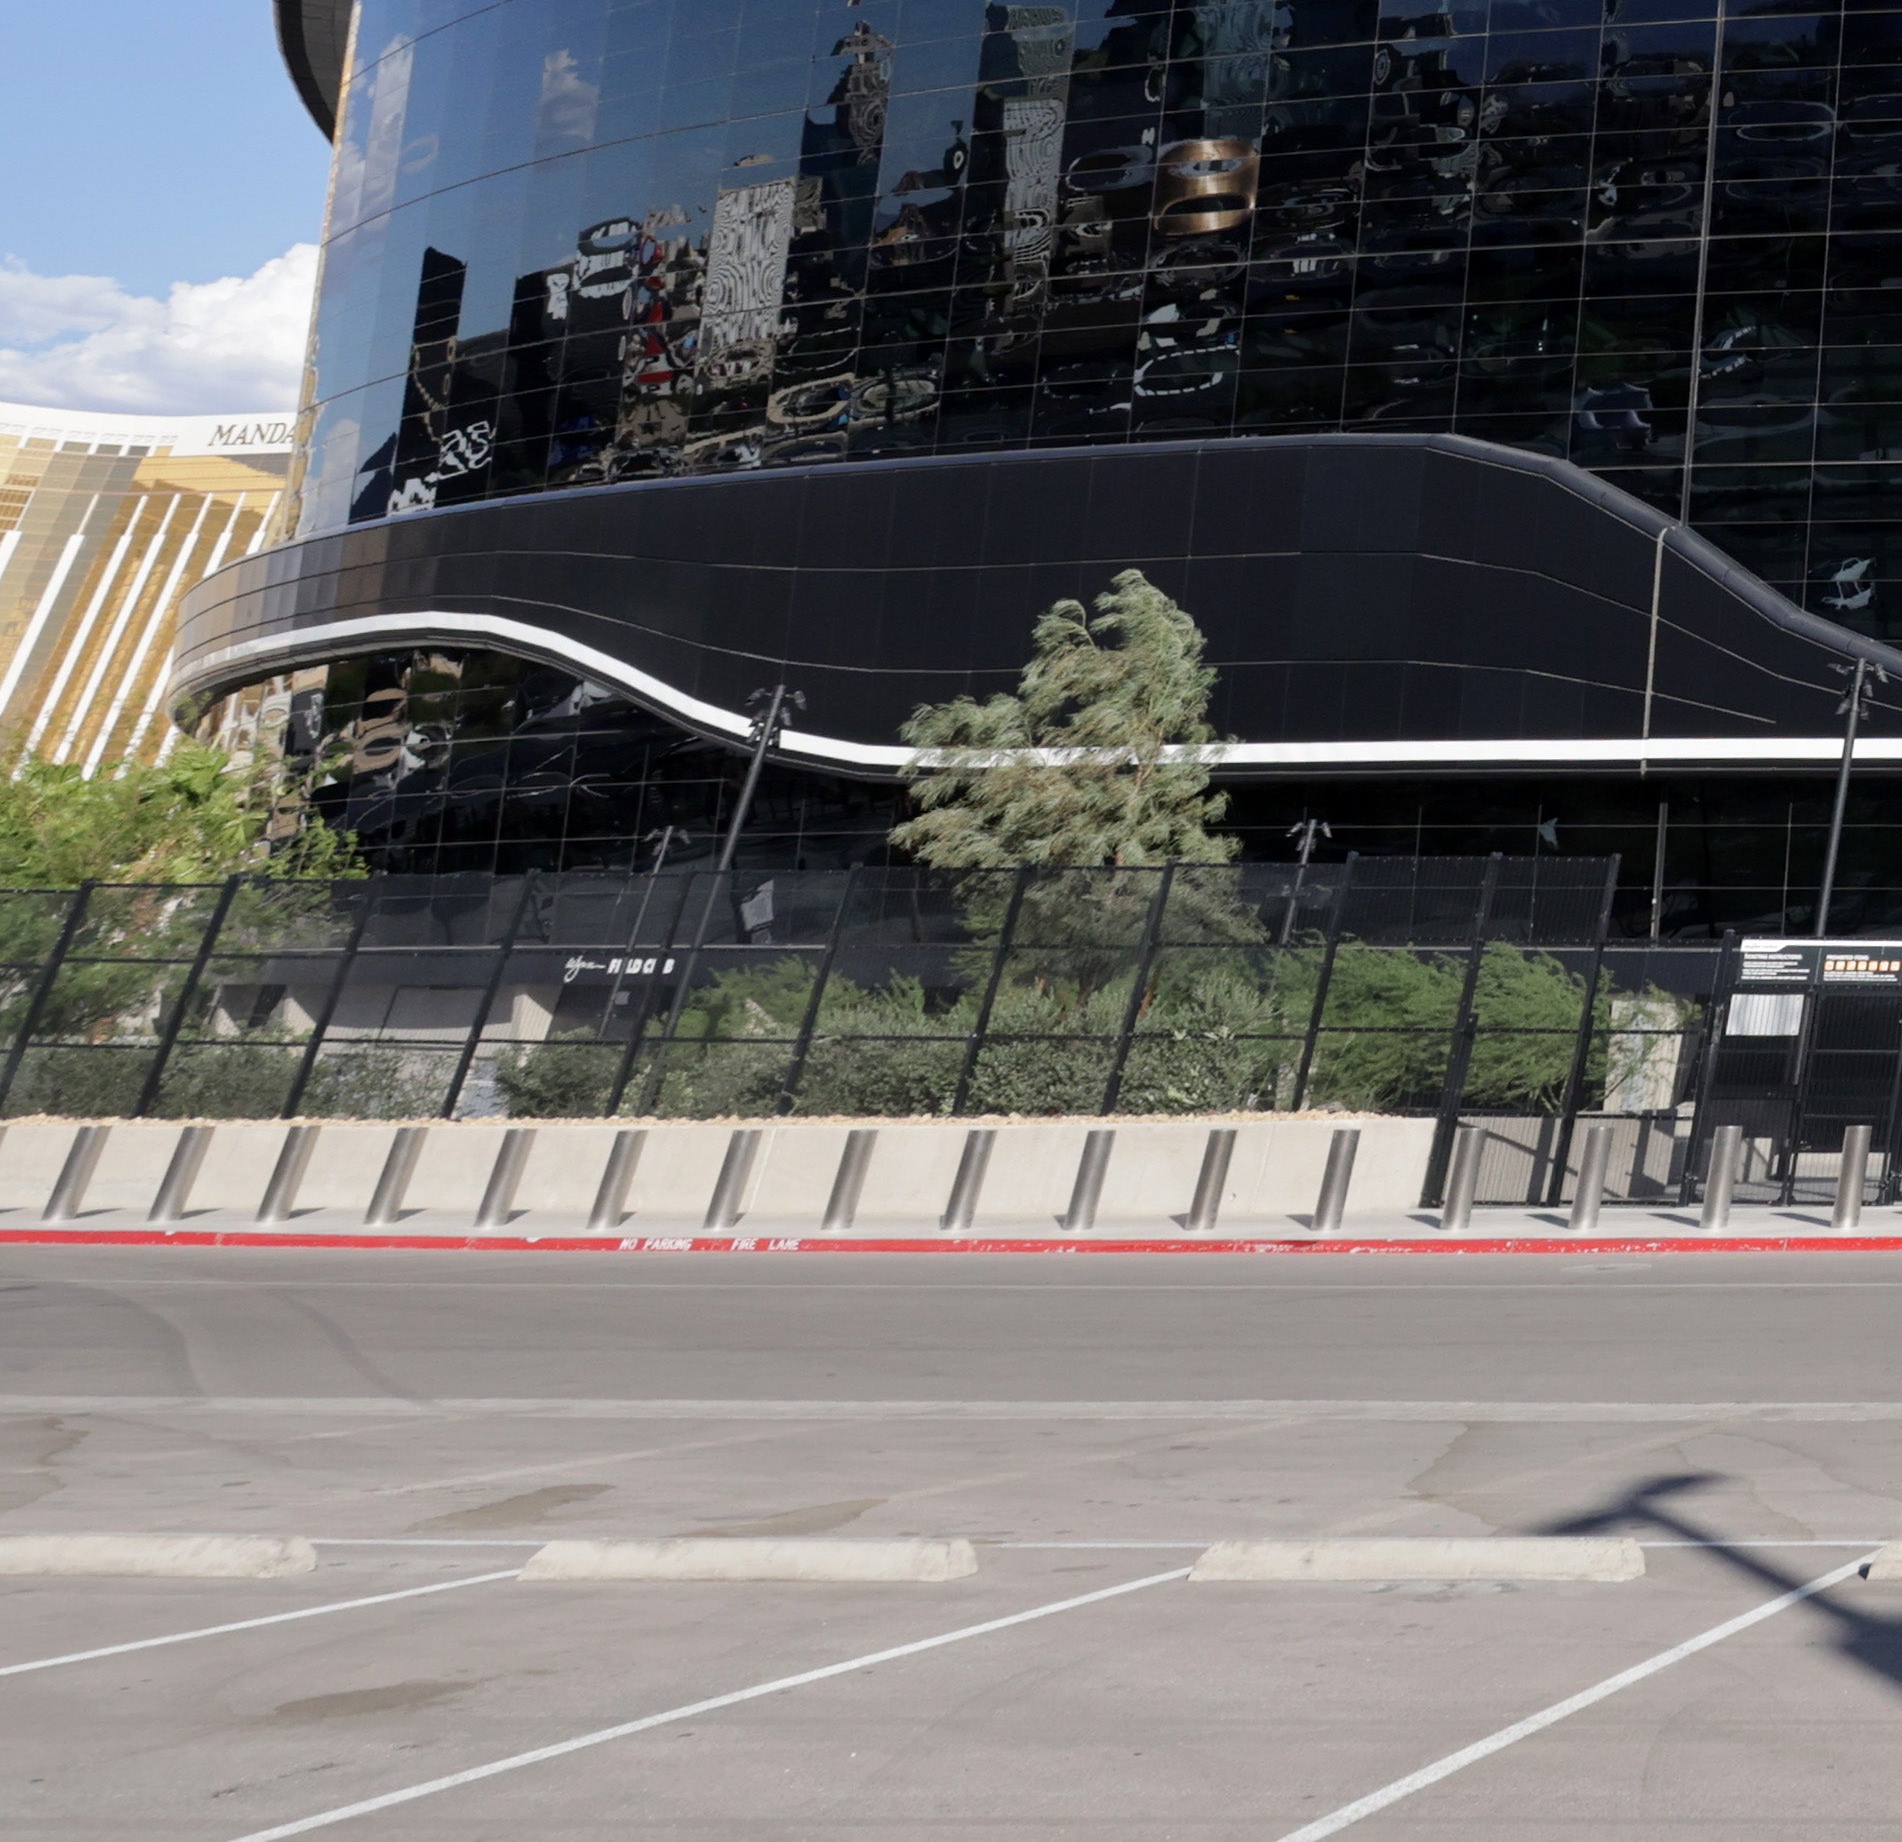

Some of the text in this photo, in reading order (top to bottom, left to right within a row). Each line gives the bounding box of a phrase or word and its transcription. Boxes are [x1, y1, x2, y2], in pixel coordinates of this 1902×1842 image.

[607, 958, 643, 974] FILD
[642, 958, 676, 974] CLB
[619, 1238, 802, 1252] NO PARKING FIRE LANE
